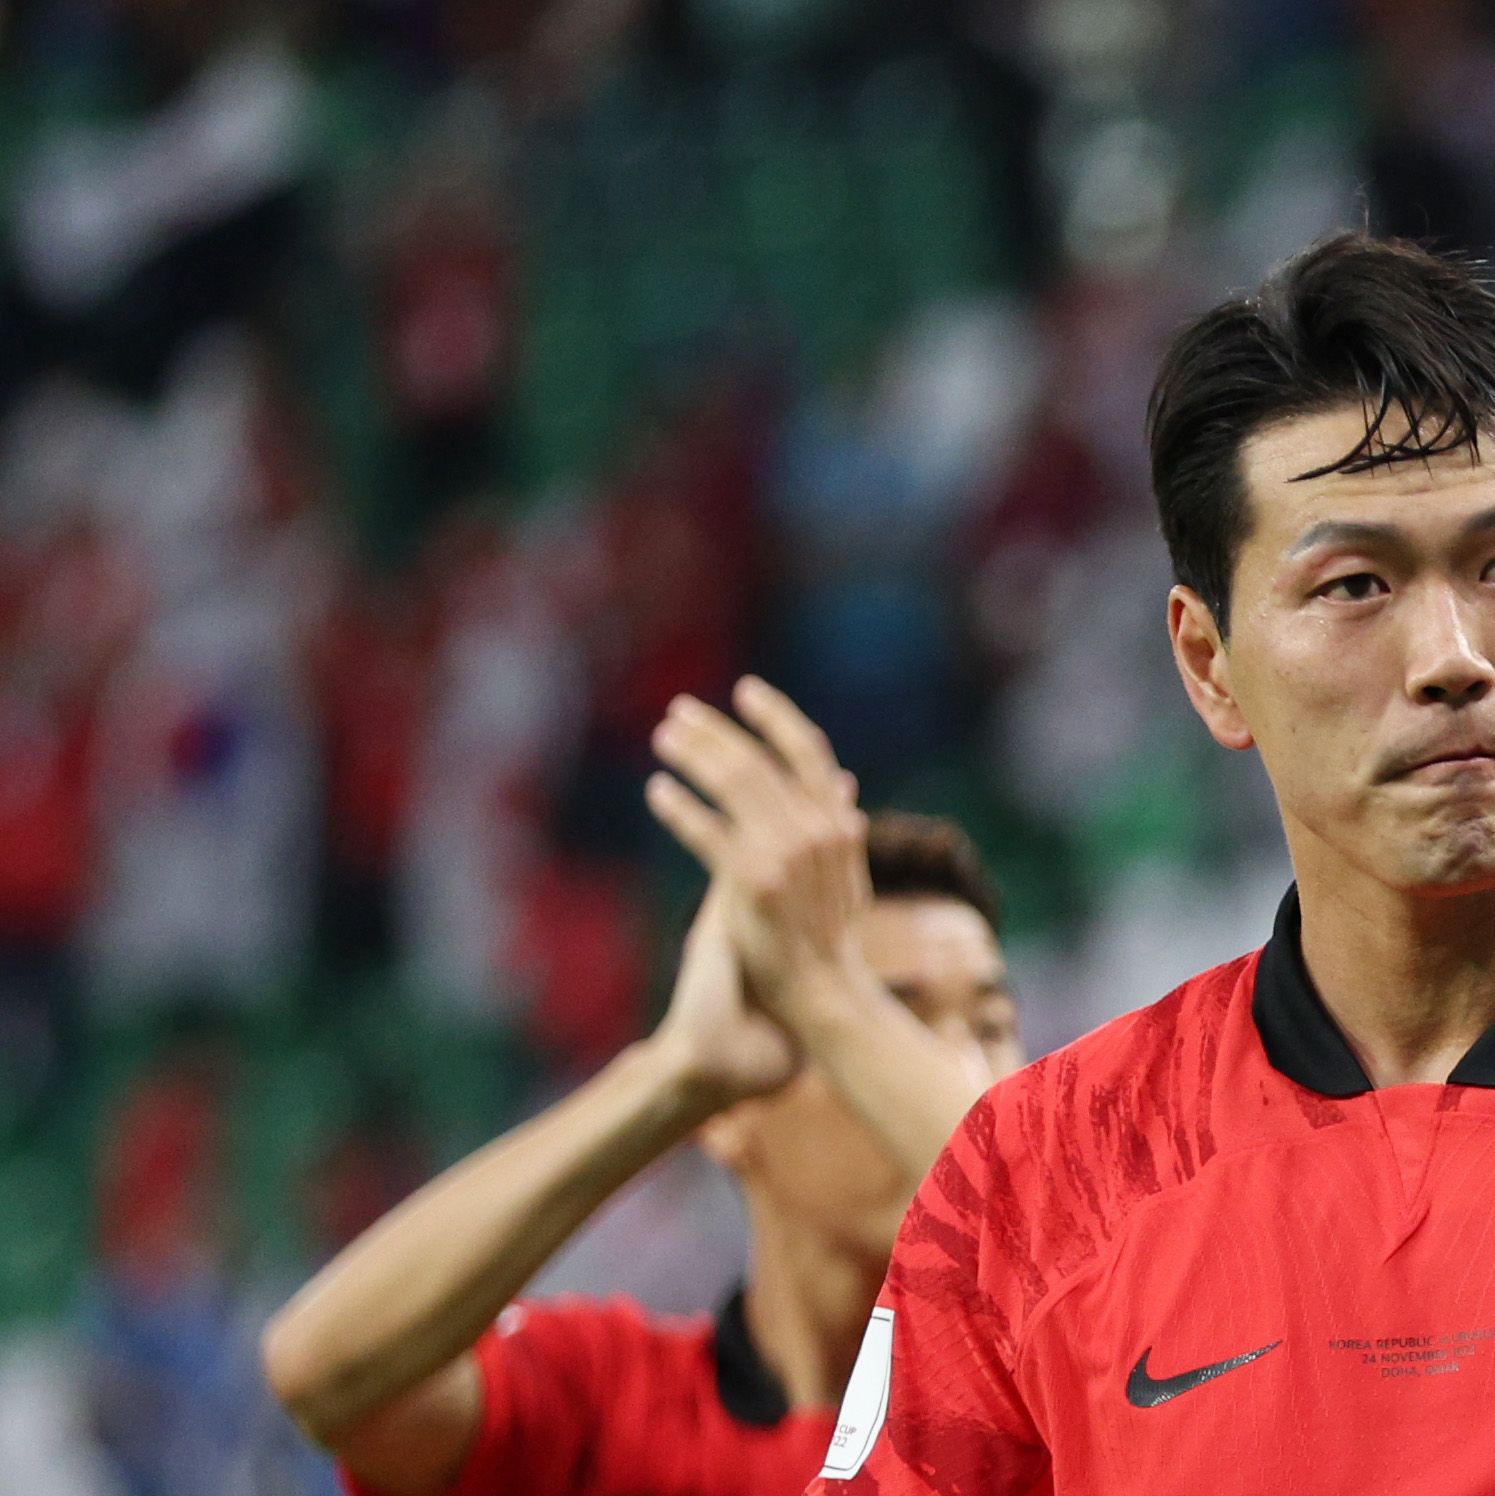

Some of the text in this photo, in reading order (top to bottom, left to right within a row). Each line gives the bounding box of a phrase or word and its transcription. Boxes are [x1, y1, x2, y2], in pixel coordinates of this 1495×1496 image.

[1328, 1338, 1372, 1351] KOREA
[1376, 1336, 1433, 1350] REPUBLIC
[1362, 1353, 1376, 1364] 24
[1381, 1348, 1448, 1364] NOVEMBER
[1381, 1366, 1420, 1378] DOHA,
